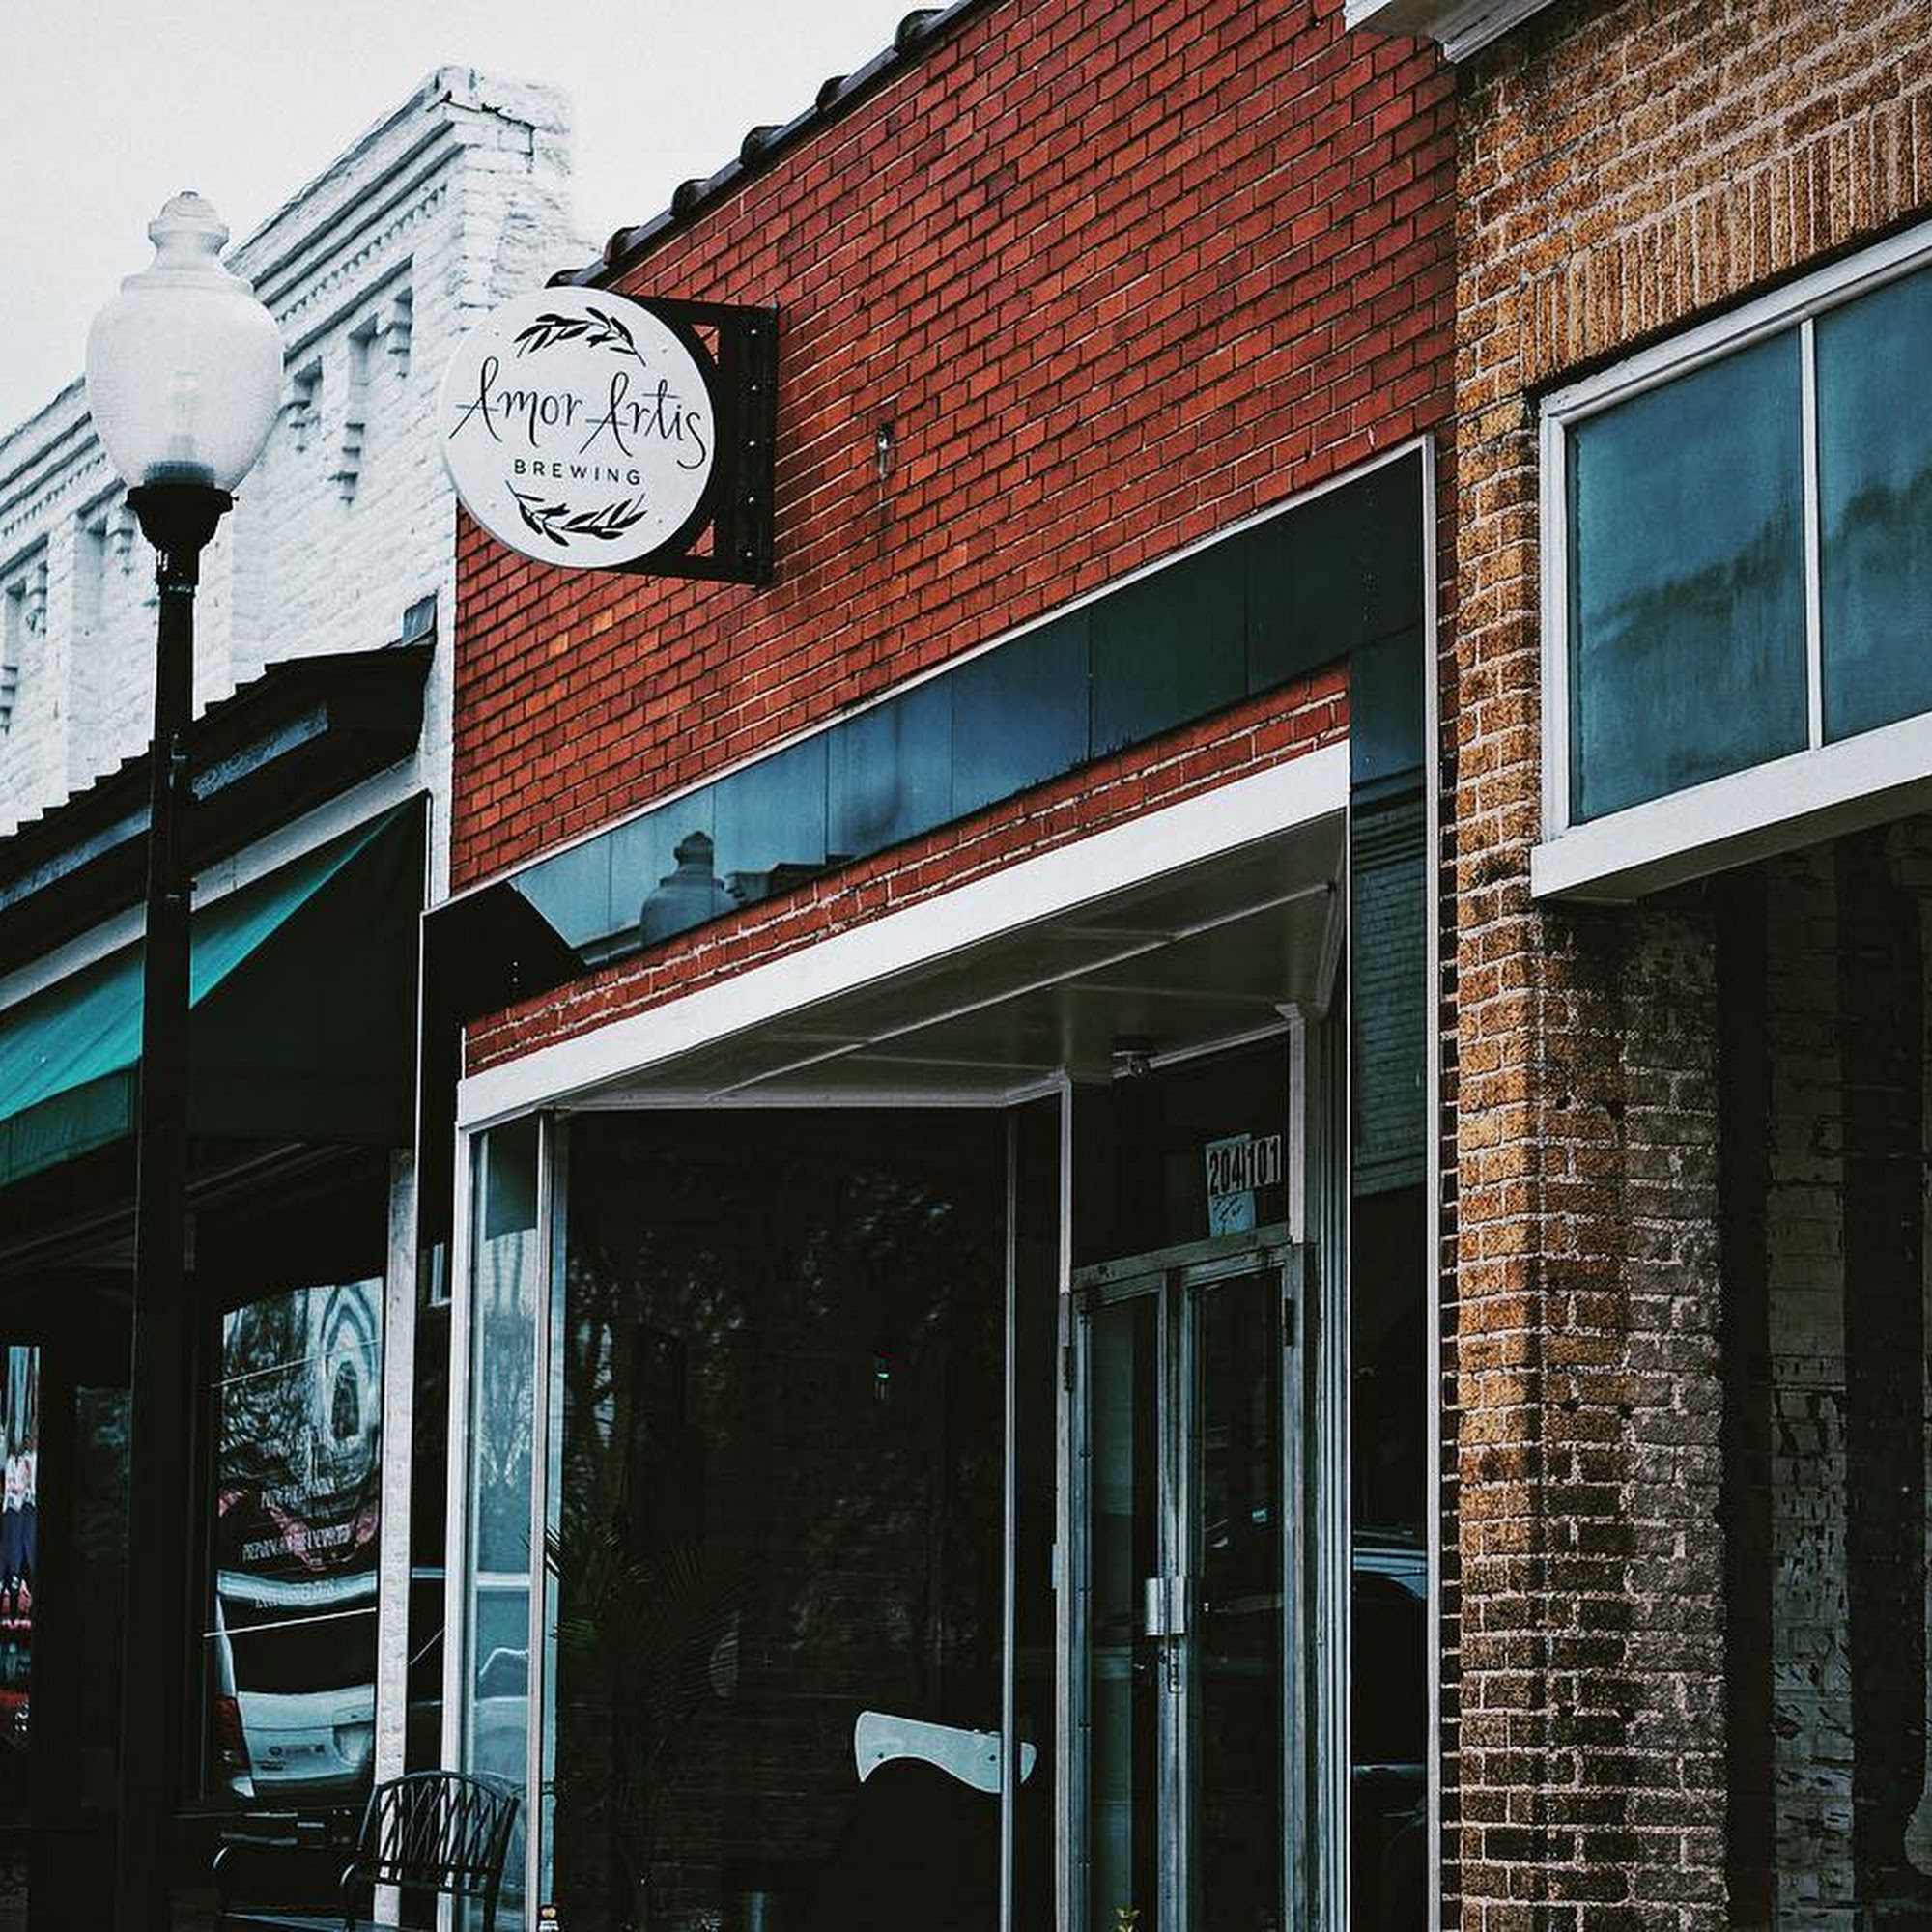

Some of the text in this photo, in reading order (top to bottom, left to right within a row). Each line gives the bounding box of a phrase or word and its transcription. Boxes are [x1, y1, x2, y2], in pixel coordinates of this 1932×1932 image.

[449, 356, 706, 469] Amor Artis
[515, 459, 640, 485] BREWING
